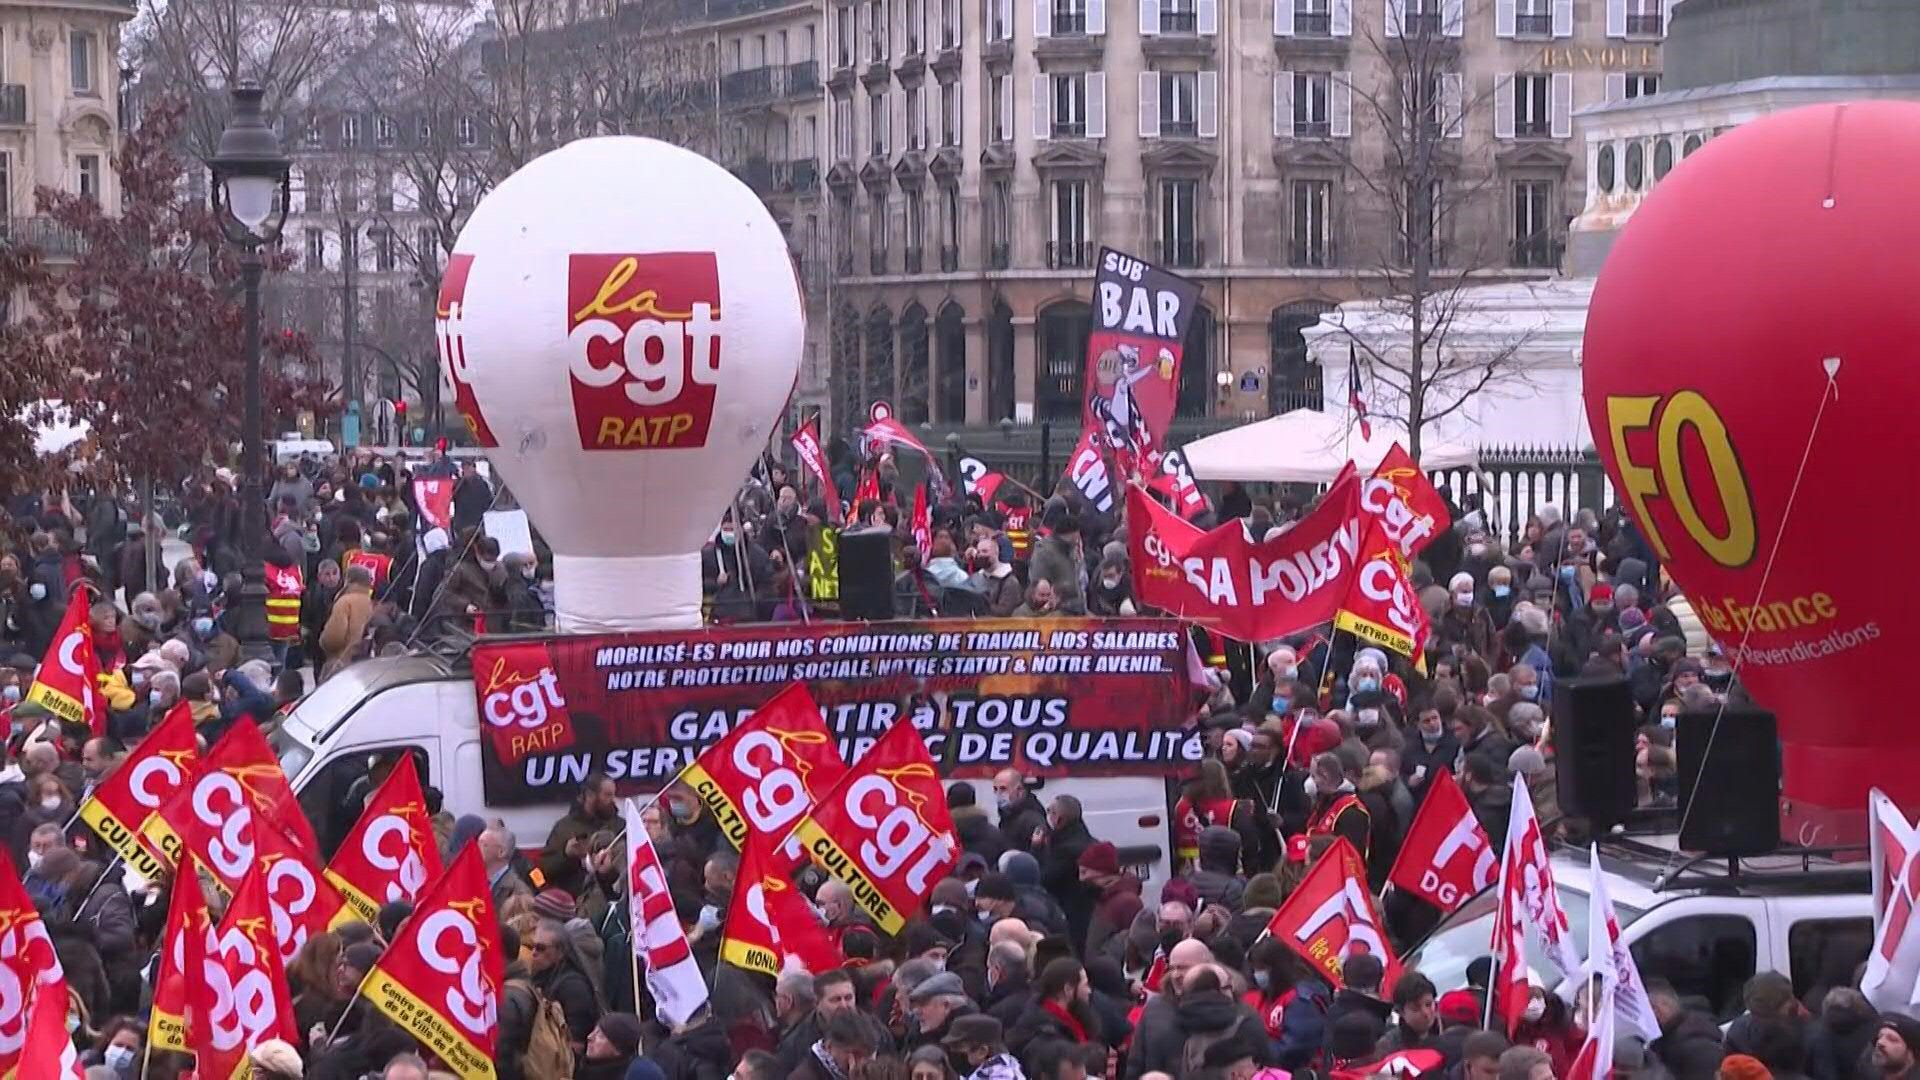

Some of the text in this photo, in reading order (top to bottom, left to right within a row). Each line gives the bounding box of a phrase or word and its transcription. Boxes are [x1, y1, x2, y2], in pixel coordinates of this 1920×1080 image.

[575, 257, 692, 321] la
[1100, 281, 1180, 337] BAR
[568, 301, 720, 406] cgt
[598, 413, 693, 446] RATP
[1606, 390, 1756, 567] FO
[1724, 592, 1837, 632] France
[596, 631, 1180, 666] MOBILISÉ-ES POUR NOS CONDITIONS DE TRAVAIL, NOS SALAIRES,
[608, 669, 666, 690] NOTRE
[670, 663, 788, 686] PROTECTION
[941, 656, 1010, 675] STATUT
[1014, 659, 1027, 673] &
[1032, 656, 1091, 673] NOTRE
[484, 666, 565, 728] cgt
[952, 699, 1067, 728] TOUS
[511, 722, 564, 757] RATP
[526, 753, 591, 786] UN
[959, 732, 1012, 762] DE
[846, 774, 953, 895] cgt
[813, 837, 890, 922] CULTURE
